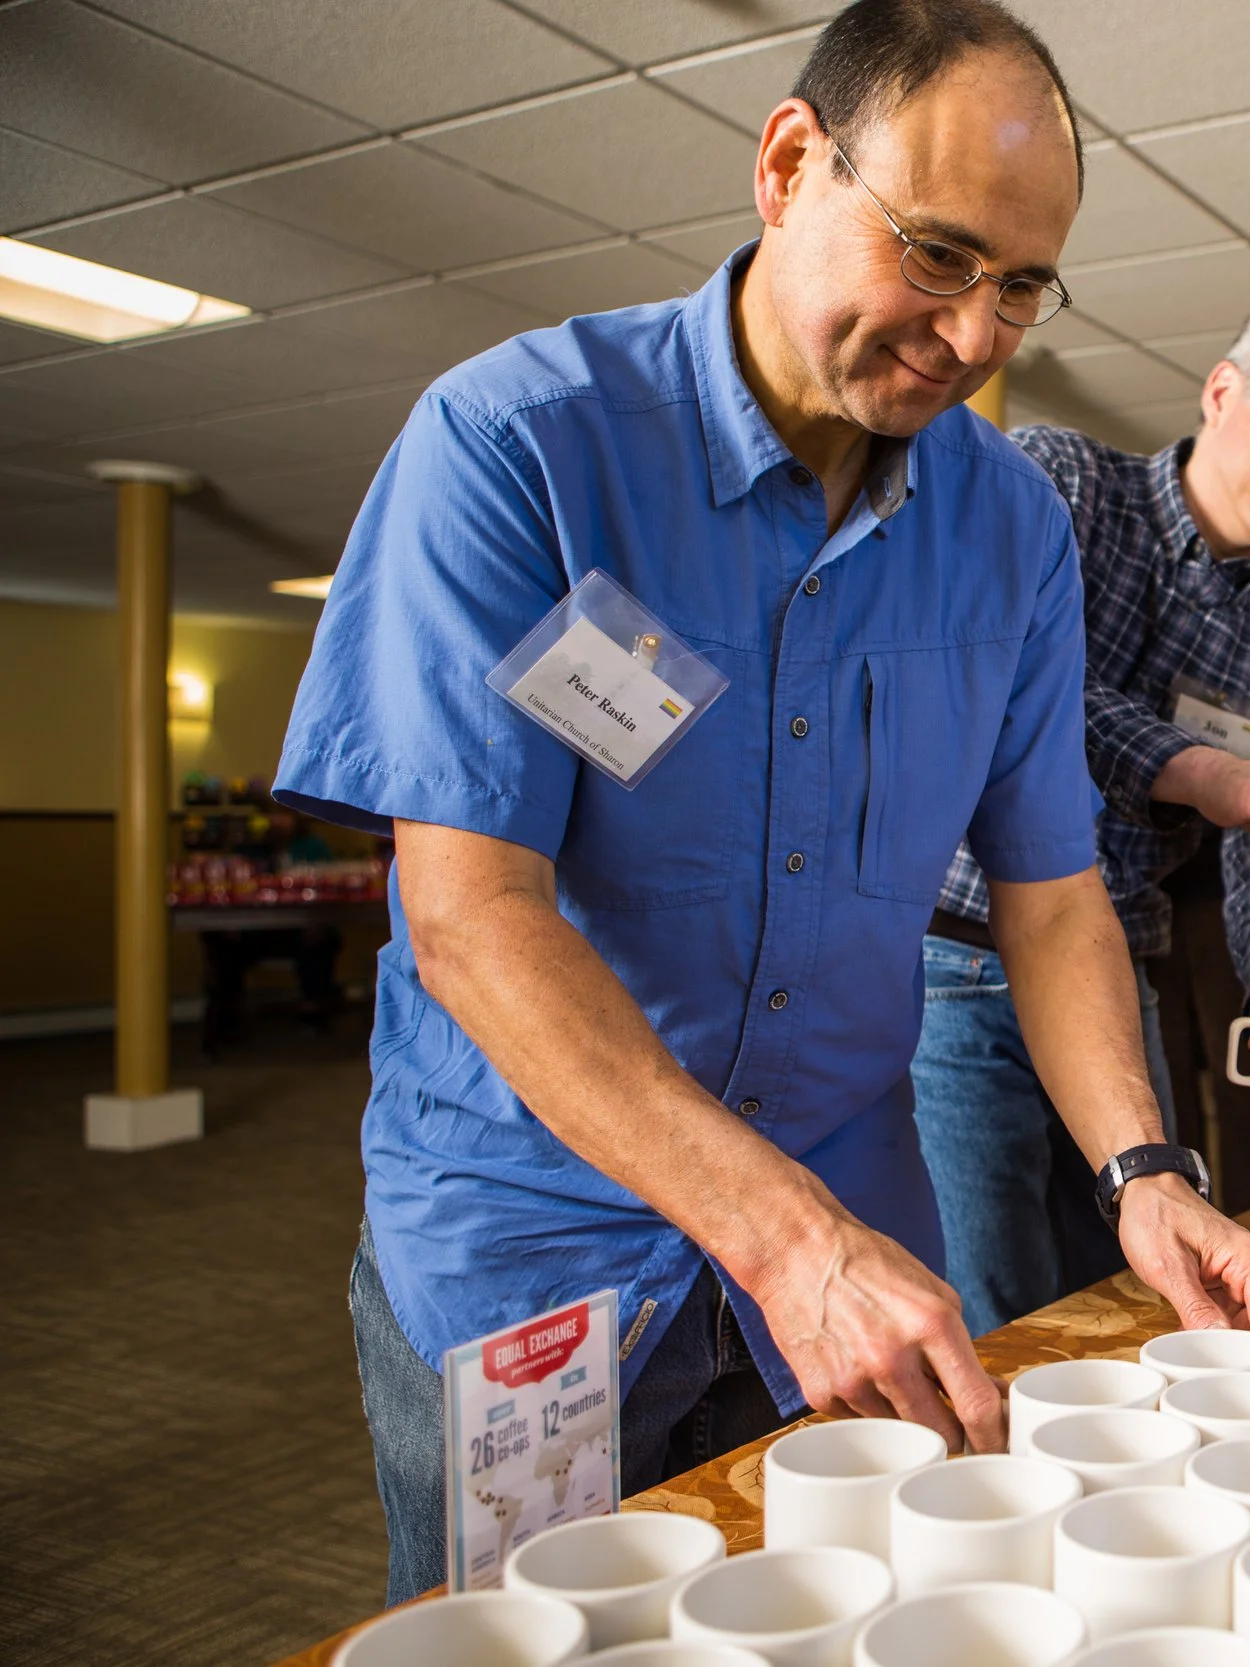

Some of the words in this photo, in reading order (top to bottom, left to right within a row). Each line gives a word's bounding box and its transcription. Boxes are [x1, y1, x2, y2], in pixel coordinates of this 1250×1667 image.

[567, 673, 599, 702] Peter
[598, 697, 637, 732] Raskin
[527, 693, 562, 723] Unitarian
[562, 720, 590, 744] Church
[589, 742, 602, 752] of
[598, 747, 625, 770] Sharon
[496, 1339, 527, 1370] EQUAL
[530, 1317, 579, 1355] EXCHANGE
[511, 1356, 545, 1379] partners
[545, 1347, 564, 1362] with:
[542, 1399, 561, 1440] 12
[562, 1388, 607, 1422] countries
[471, 1430, 495, 1476] 26
[498, 1417, 528, 1444] coffee
[498, 1435, 530, 1462] co-ops
